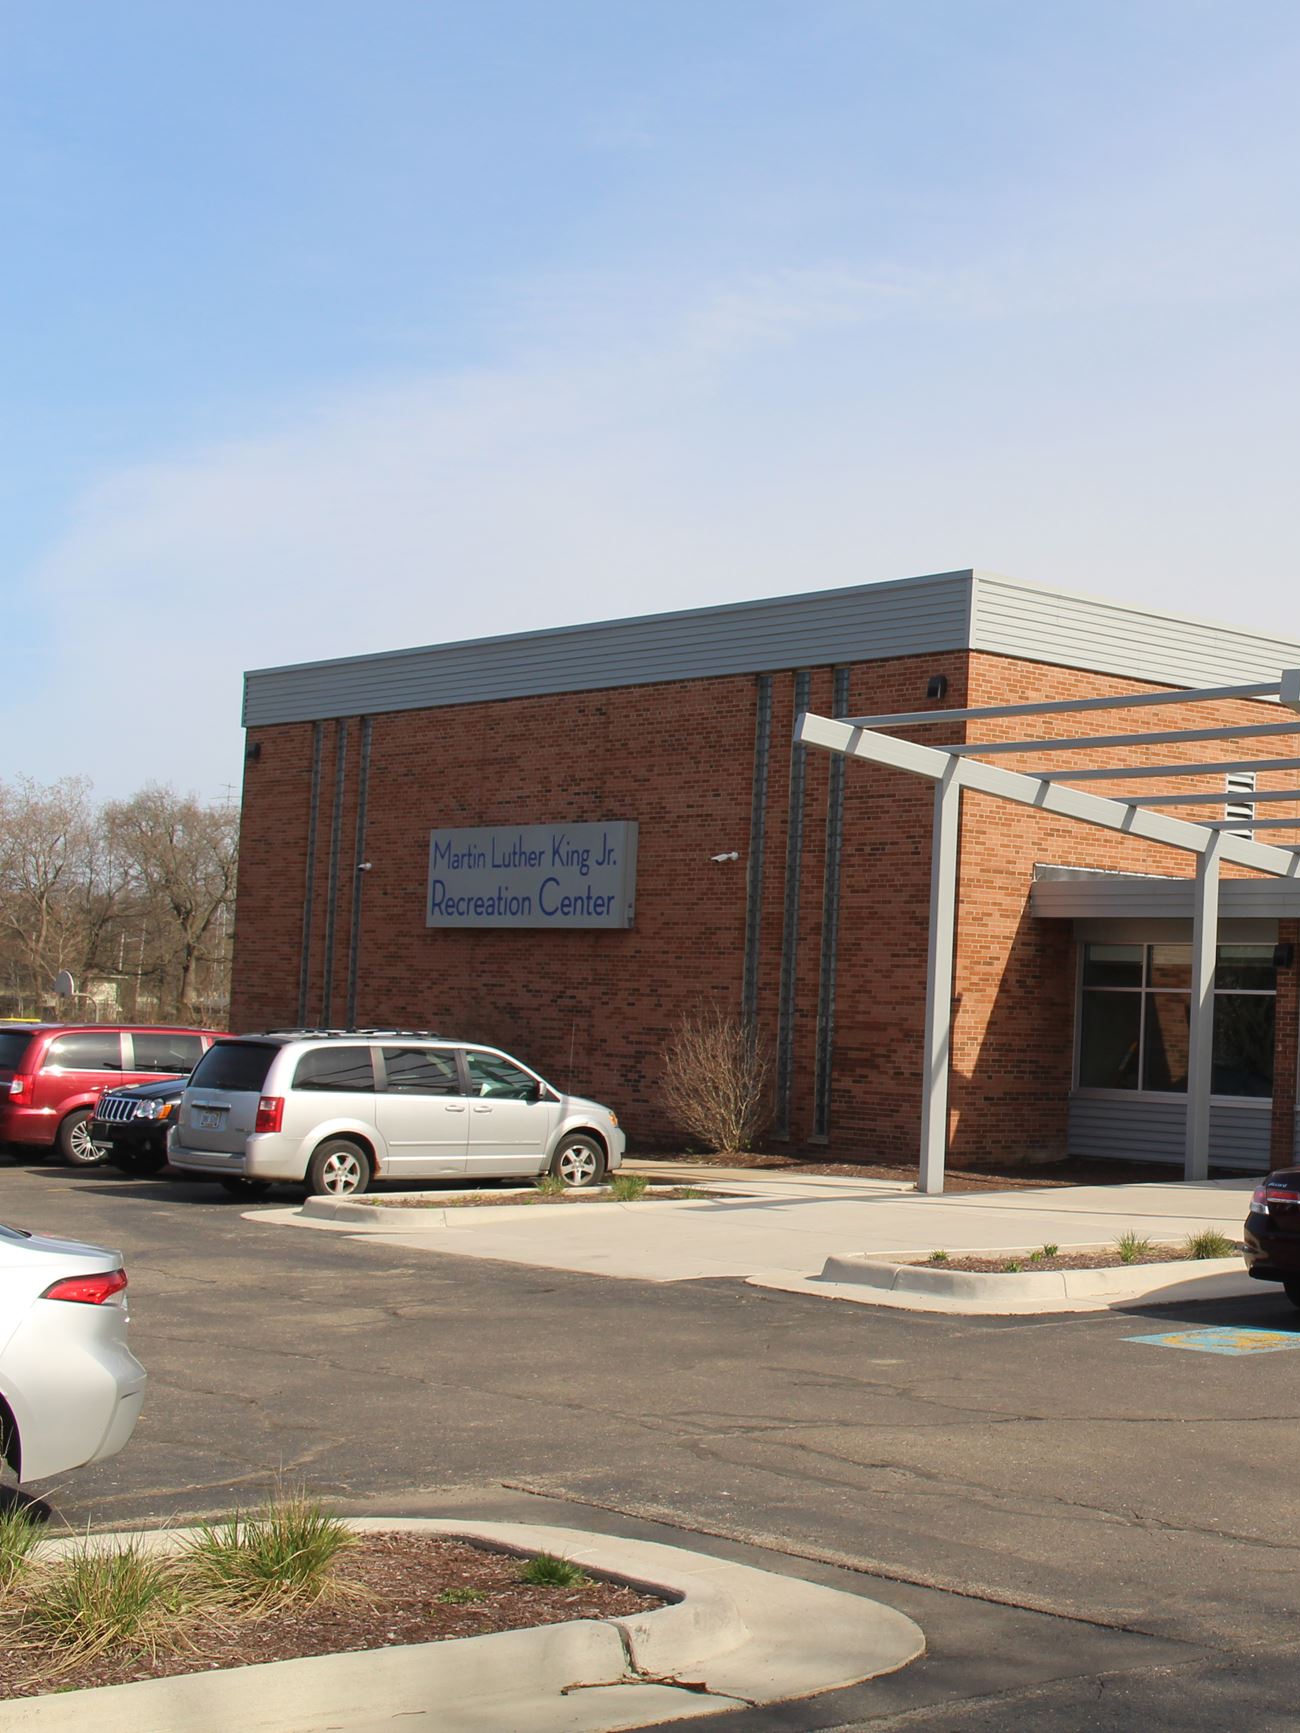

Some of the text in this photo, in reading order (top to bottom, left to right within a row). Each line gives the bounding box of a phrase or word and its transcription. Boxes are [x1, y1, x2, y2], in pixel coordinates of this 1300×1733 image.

[433, 832, 617, 876] Martin Luther King Jr.
[431, 877, 615, 916] Recreation Center
